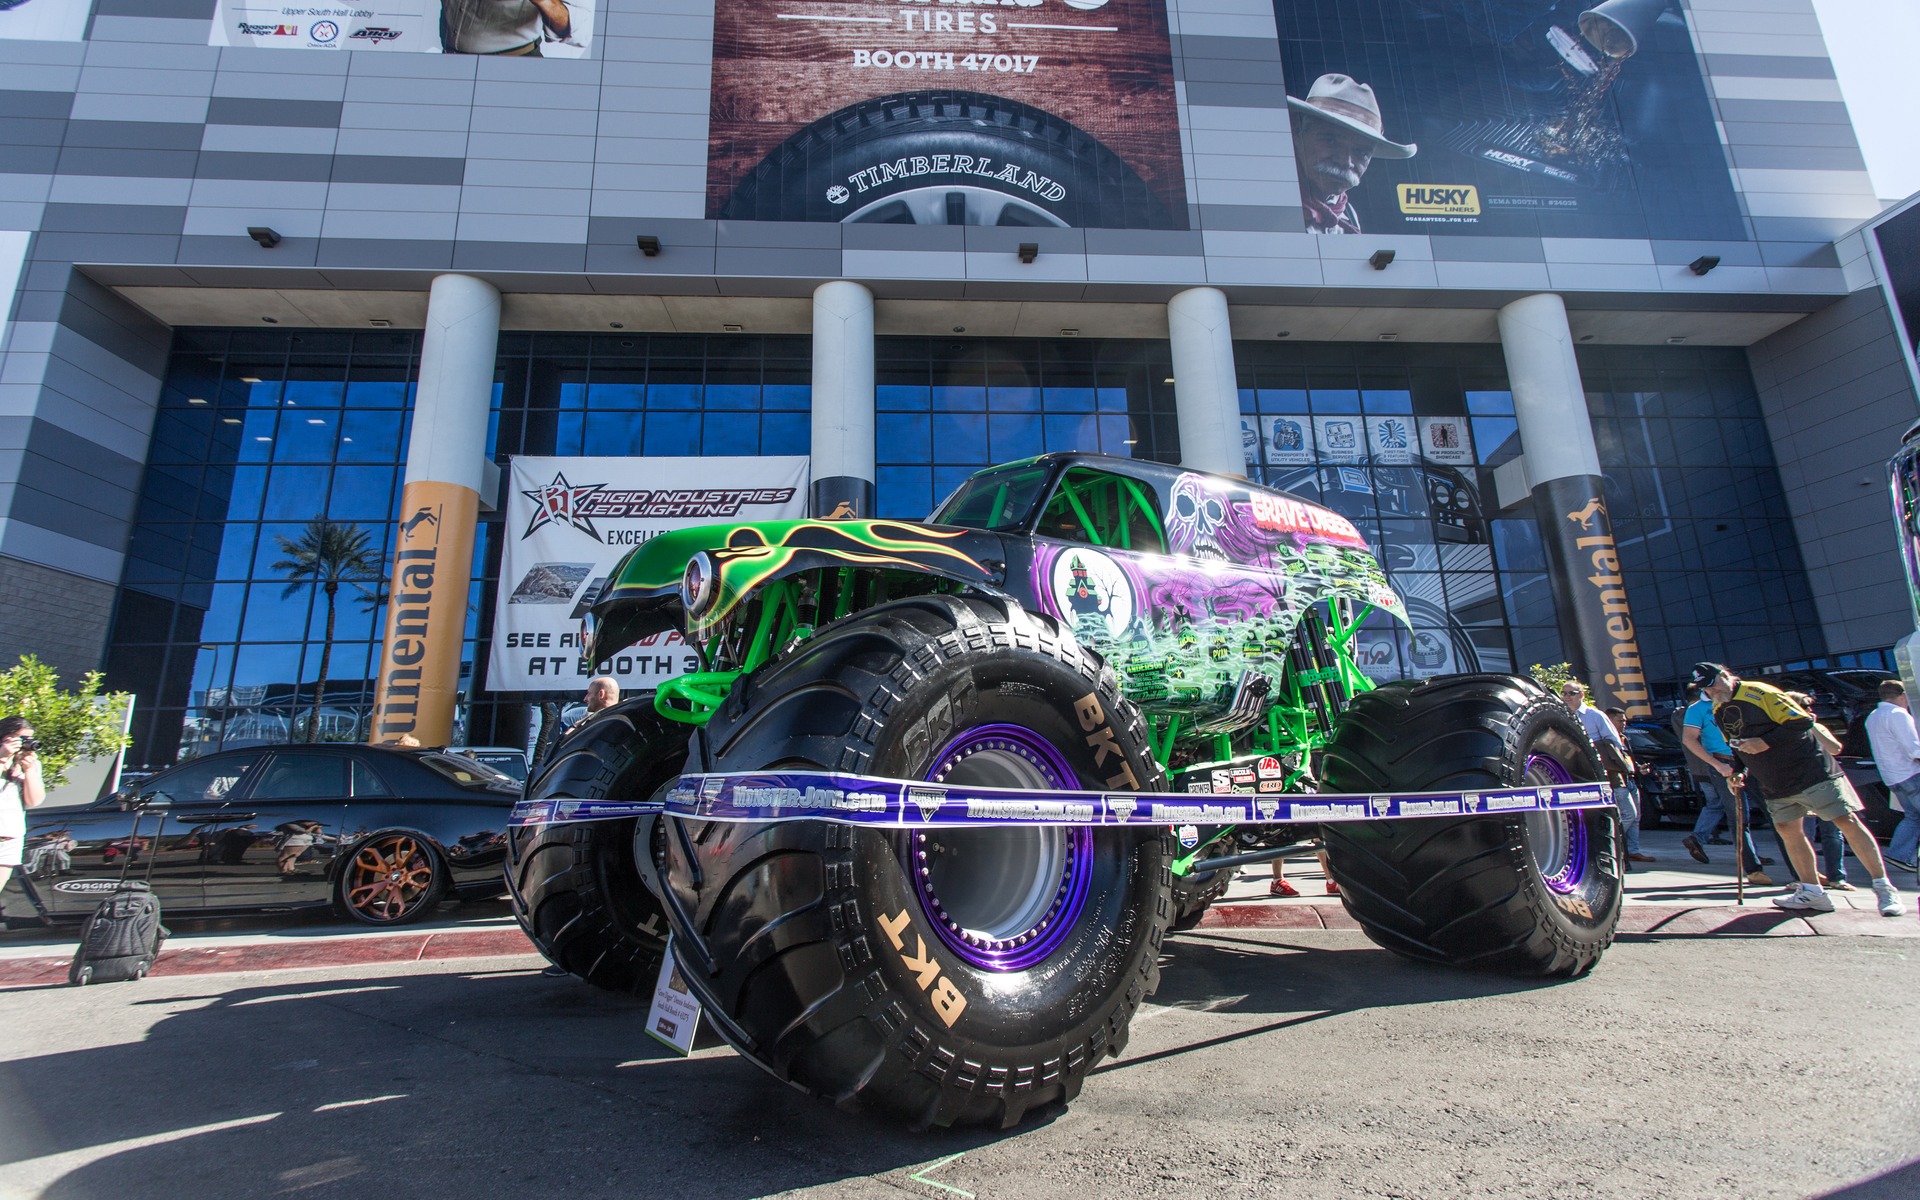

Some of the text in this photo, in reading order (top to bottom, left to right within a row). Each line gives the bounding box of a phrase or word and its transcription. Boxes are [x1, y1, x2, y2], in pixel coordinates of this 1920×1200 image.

[281, 7, 374, 19] Upper South Hall Lobby
[899, 10, 998, 34] TIRES
[238, 22, 277, 30] Rugged
[242, 28, 272, 36] Ridge
[352, 29, 399, 38] Alloy
[853, 49, 1040, 73] BOOTH 47017
[1484, 148, 1535, 167] HUSKY
[848, 154, 1066, 202] TIMBERLAND
[1405, 187, 1471, 205] HUSKY
[588, 488, 790, 503] RIGID INDUSTRIES
[576, 502, 737, 516] LED LIGHTING
[1250, 493, 1310, 532] GRAVE
[377, 547, 437, 746] tinental
[506, 632, 552, 648] SEE
[528, 656, 567, 676] AT
[902, 667, 979, 777] BKT
[1073, 692, 1140, 791] BKT
[1259, 757, 1280, 770] JAZ
[877, 908, 968, 1029] BKT
